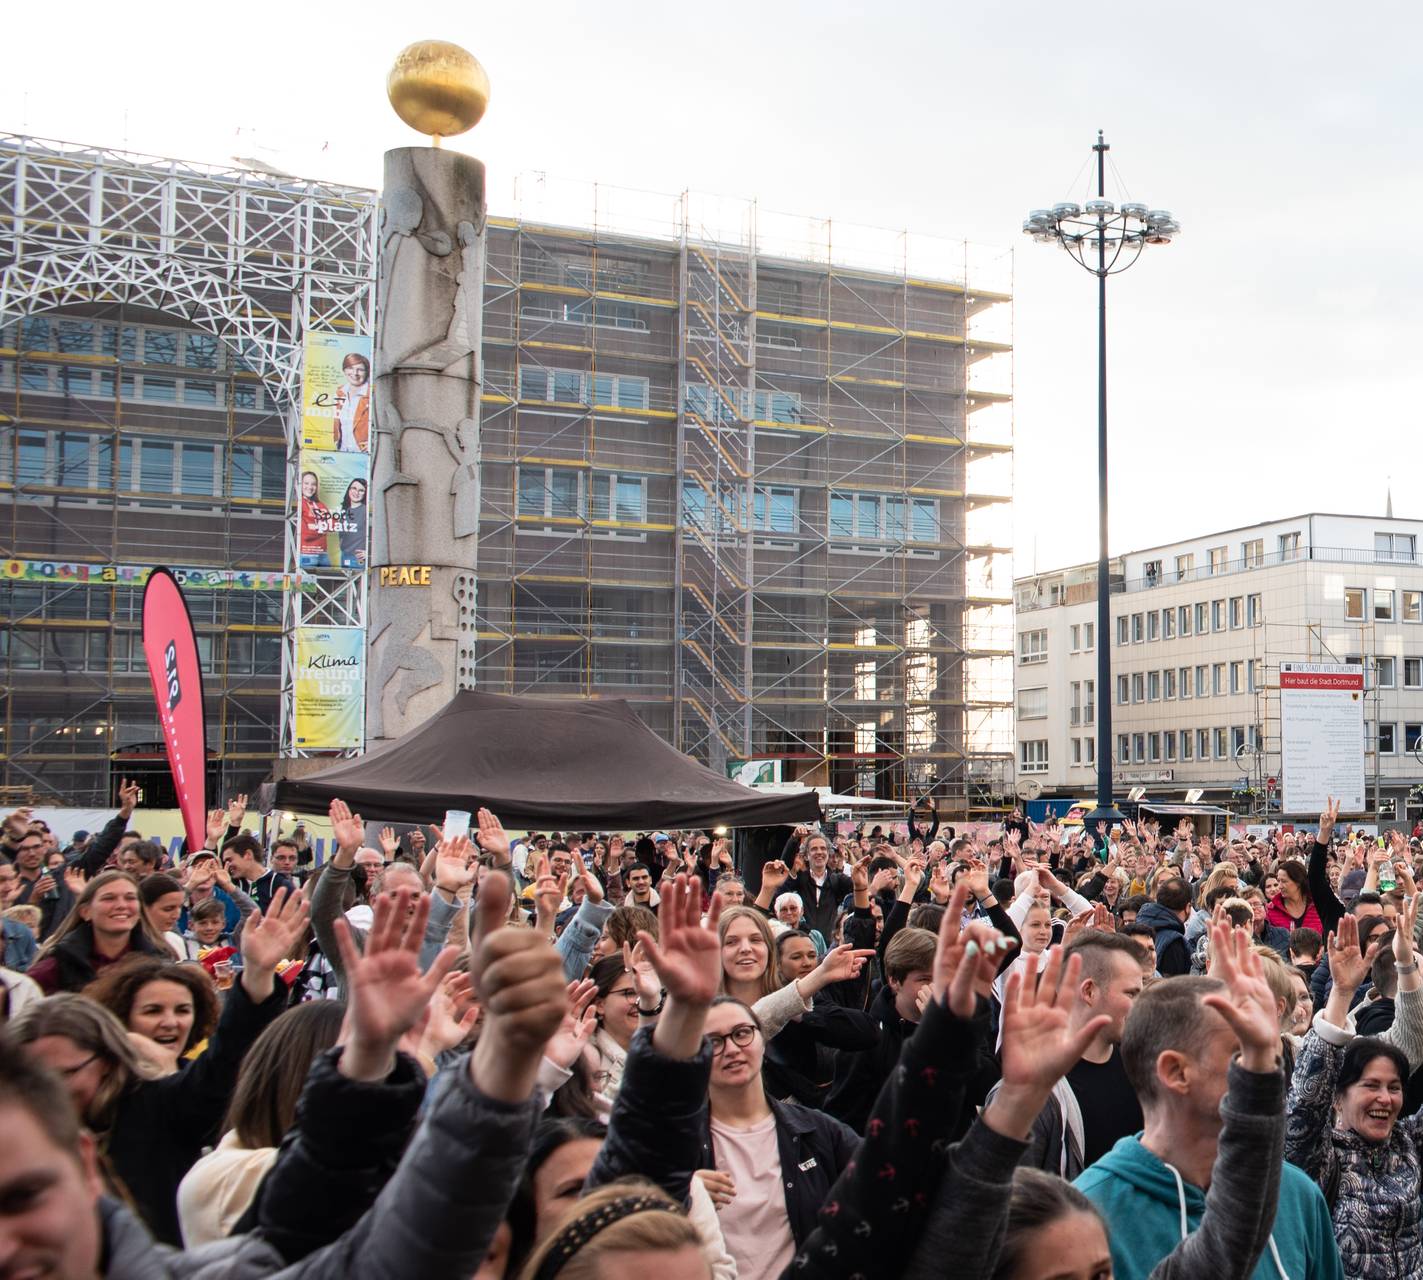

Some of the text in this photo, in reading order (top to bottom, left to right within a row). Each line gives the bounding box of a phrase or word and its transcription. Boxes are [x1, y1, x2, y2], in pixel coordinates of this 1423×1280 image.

[313, 507, 355, 522] Sport
[317, 517, 358, 533] platz
[380, 566, 431, 587] PEACE
[308, 654, 359, 669] Klima
[299, 666, 360, 681] freund
[319, 681, 353, 696] lich
[1319, 678, 1333, 686] Stadt
[1333, 678, 1359, 687] Dortmund
